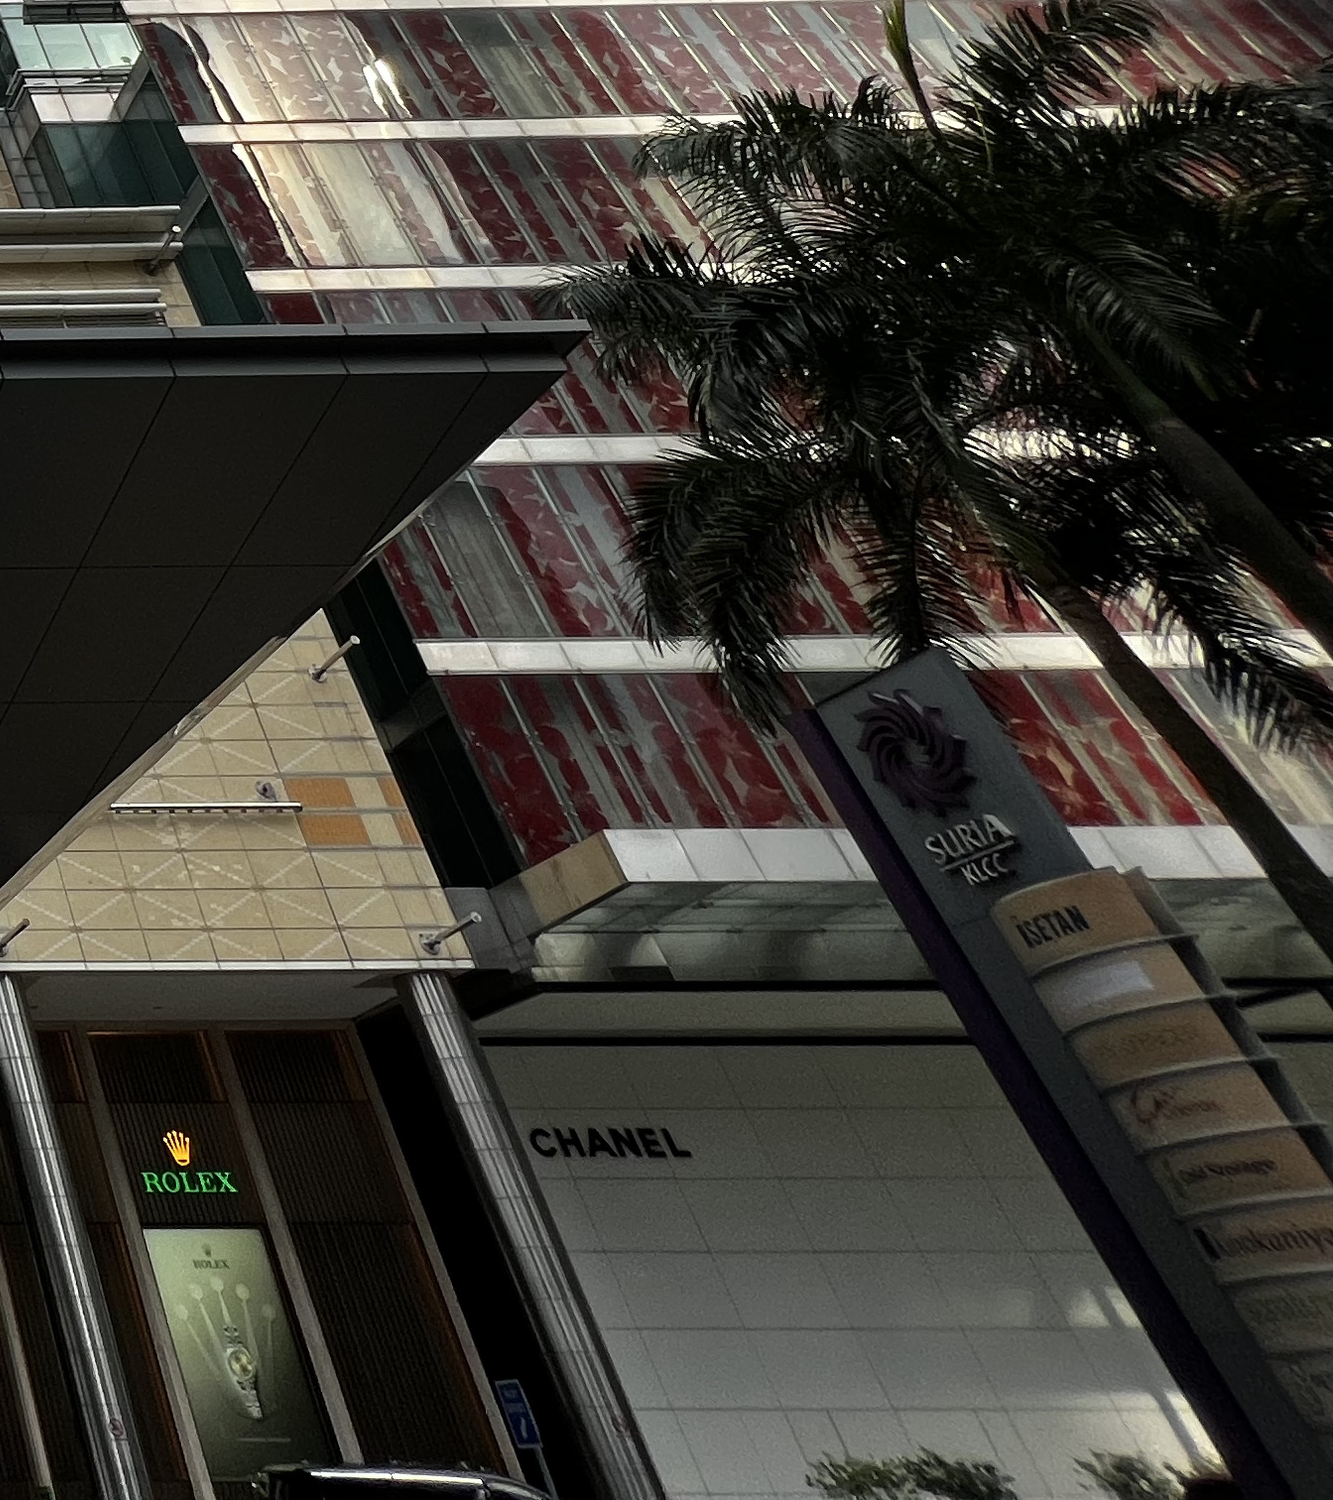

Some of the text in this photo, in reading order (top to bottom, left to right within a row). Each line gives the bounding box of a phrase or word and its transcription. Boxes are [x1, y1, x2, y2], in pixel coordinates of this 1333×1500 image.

[924, 813, 1017, 866] SURIA
[959, 852, 1010, 886] KLCC
[529, 1127, 693, 1160] CHANEL
[141, 1171, 239, 1194] ROLEX
[193, 1259, 230, 1270] ROLEX
